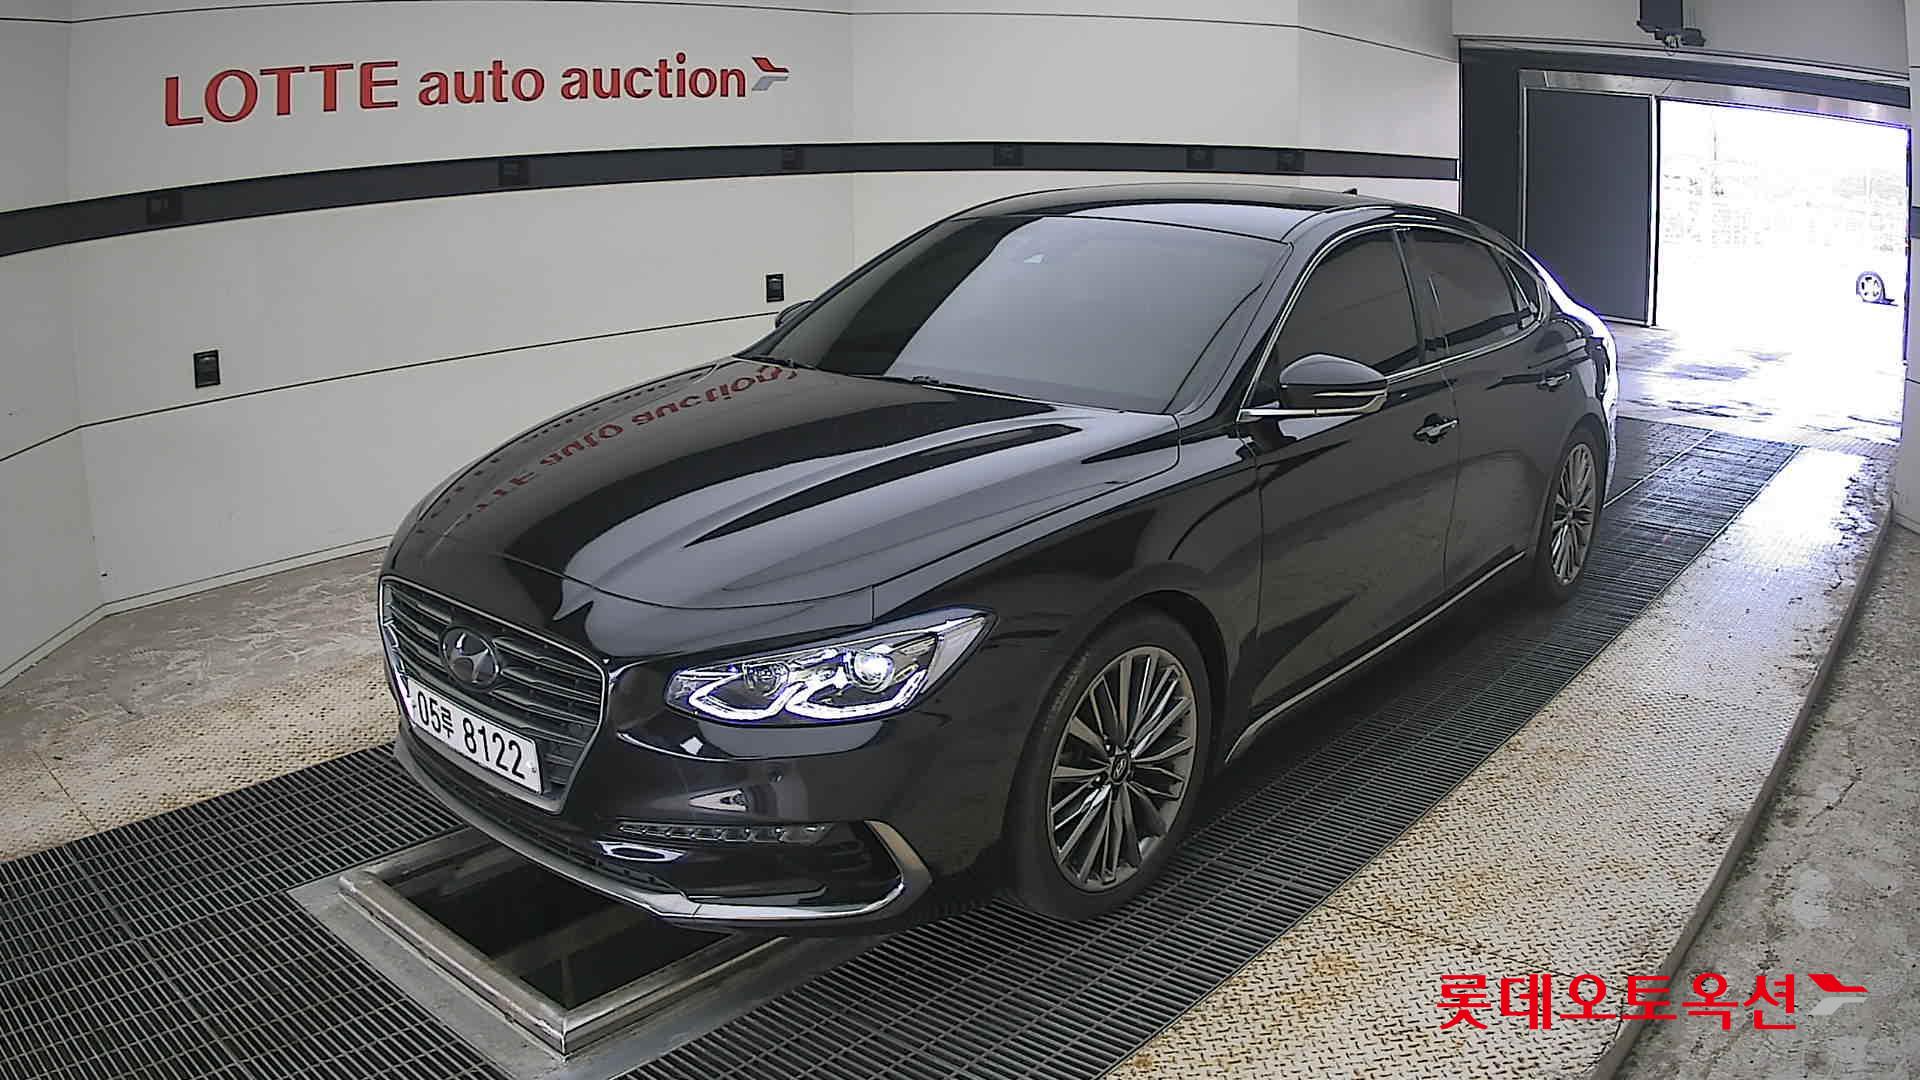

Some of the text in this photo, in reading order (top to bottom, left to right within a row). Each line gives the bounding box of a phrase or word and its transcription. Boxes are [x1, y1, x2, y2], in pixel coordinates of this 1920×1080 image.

[164, 52, 748, 128] LOTTE auto auction
[417, 690, 527, 780] 05루 8122
